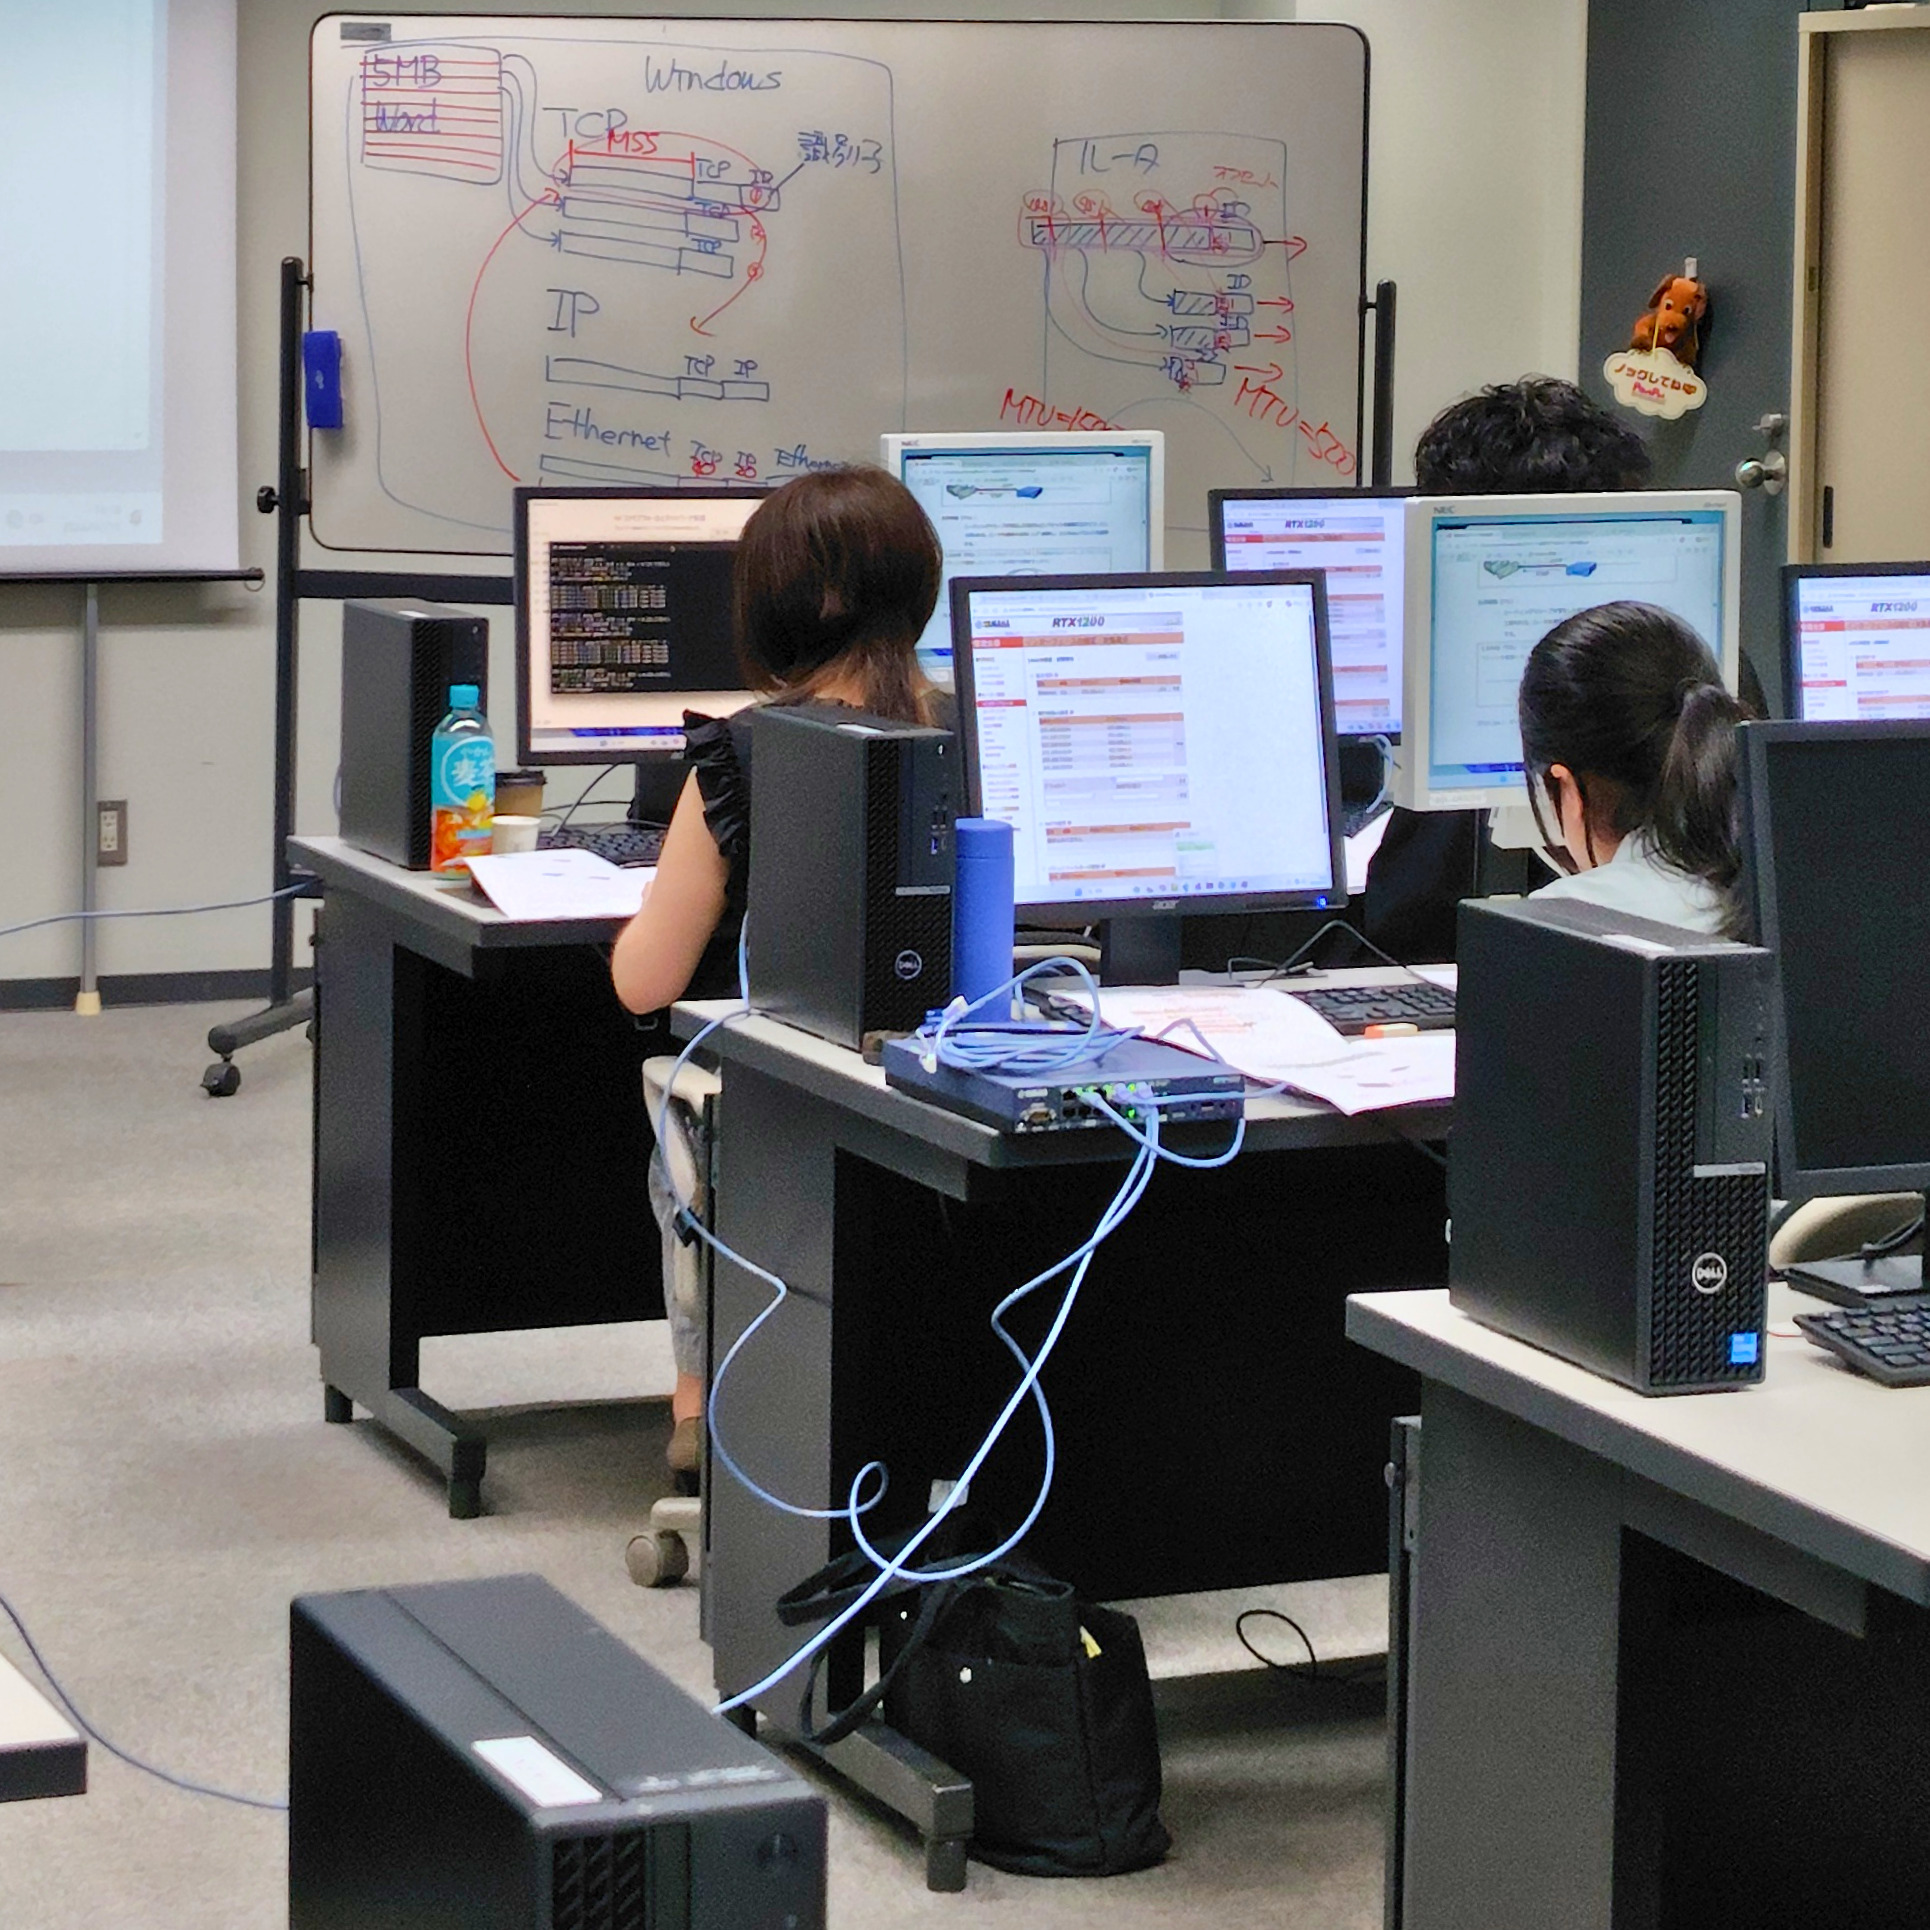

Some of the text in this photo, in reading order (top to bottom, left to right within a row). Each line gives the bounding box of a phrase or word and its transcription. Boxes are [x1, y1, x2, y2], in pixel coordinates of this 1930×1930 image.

[645, 55, 783, 93] Windows
[374, 97, 441, 133] Word
[542, 107, 627, 139] TCP
[606, 129, 660, 155] MSS
[695, 157, 731, 178] TCP
[546, 288, 600, 338] IP
[684, 355, 716, 376] TCP
[734, 359, 759, 379] IP
[544, 402, 671, 457] Ethernet
[690, 440, 723, 464] TCP
[1871, 602, 1918, 613] RTX1200
[1051, 615, 1106, 629] RTX1200
[1696, 1266, 1723, 1281] DELL
